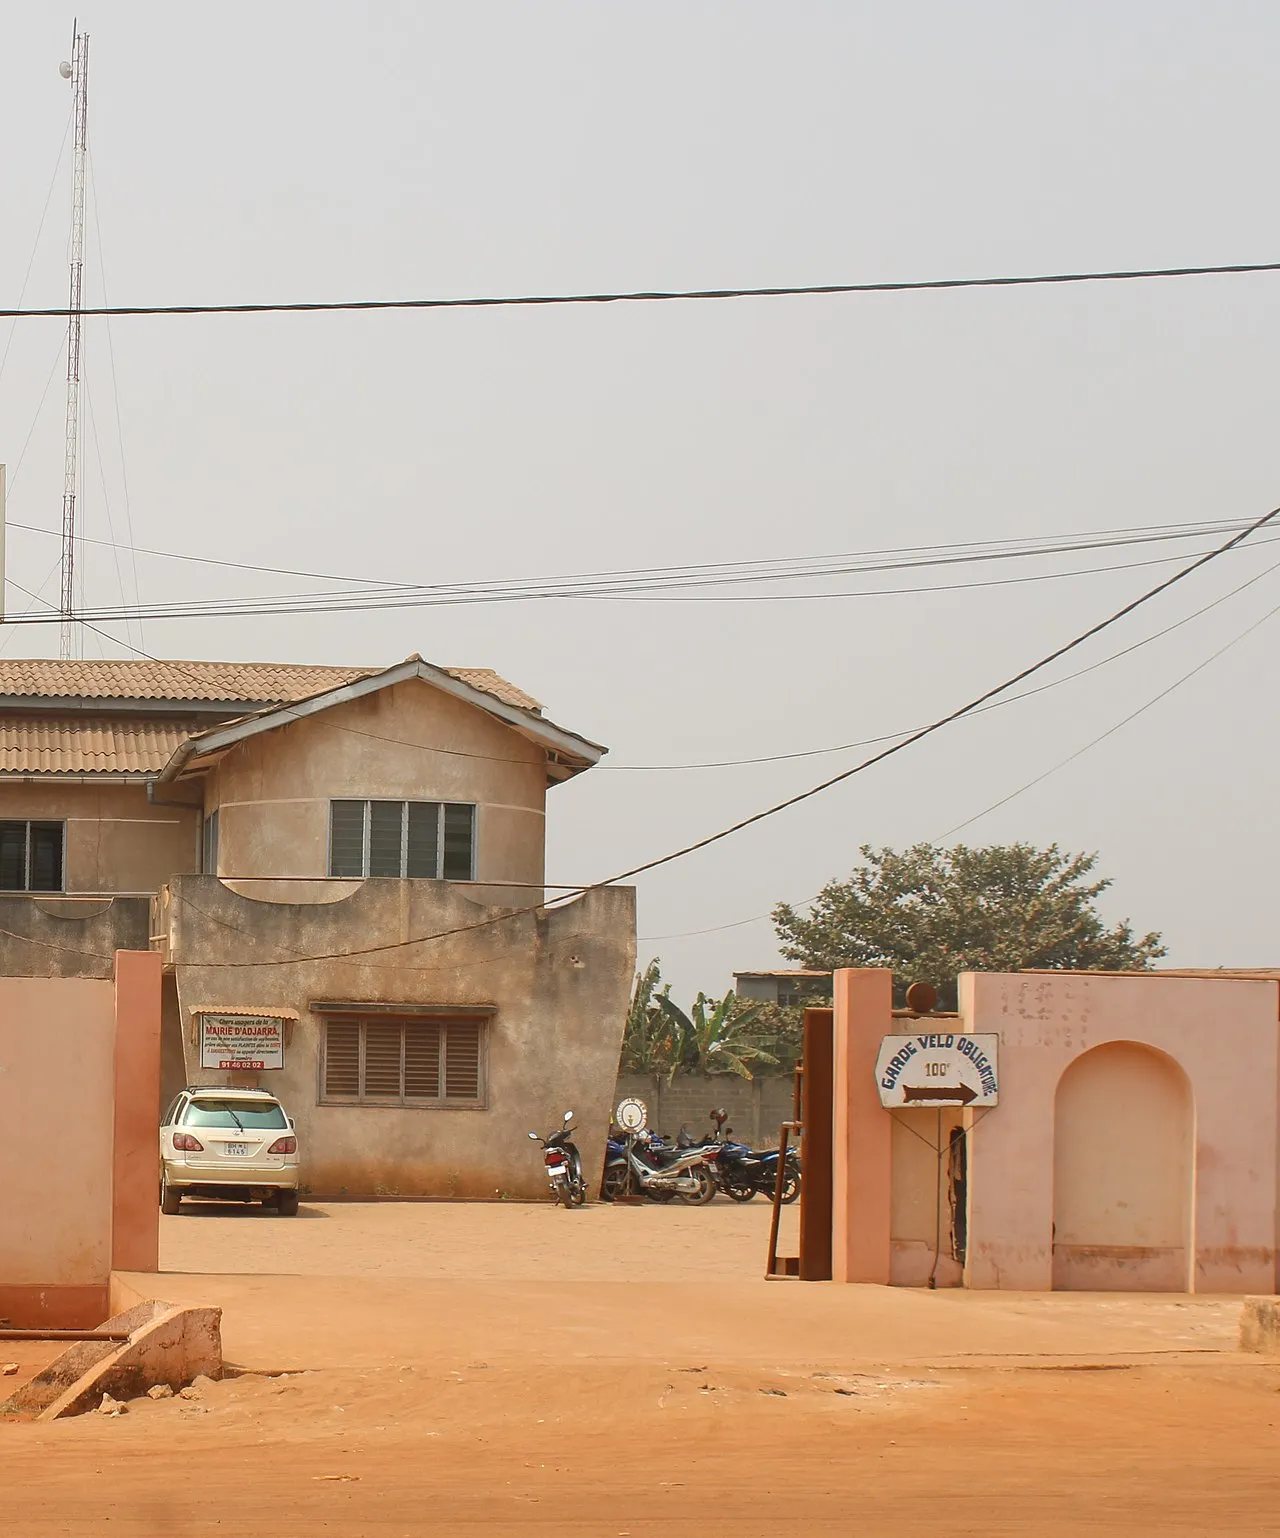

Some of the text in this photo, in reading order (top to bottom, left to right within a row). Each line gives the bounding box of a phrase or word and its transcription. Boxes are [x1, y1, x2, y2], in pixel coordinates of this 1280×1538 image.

[205, 1026, 233, 1036] MAIRIE
[881, 1034, 998, 1097] GARDE VELO OBLIGATOIRE
